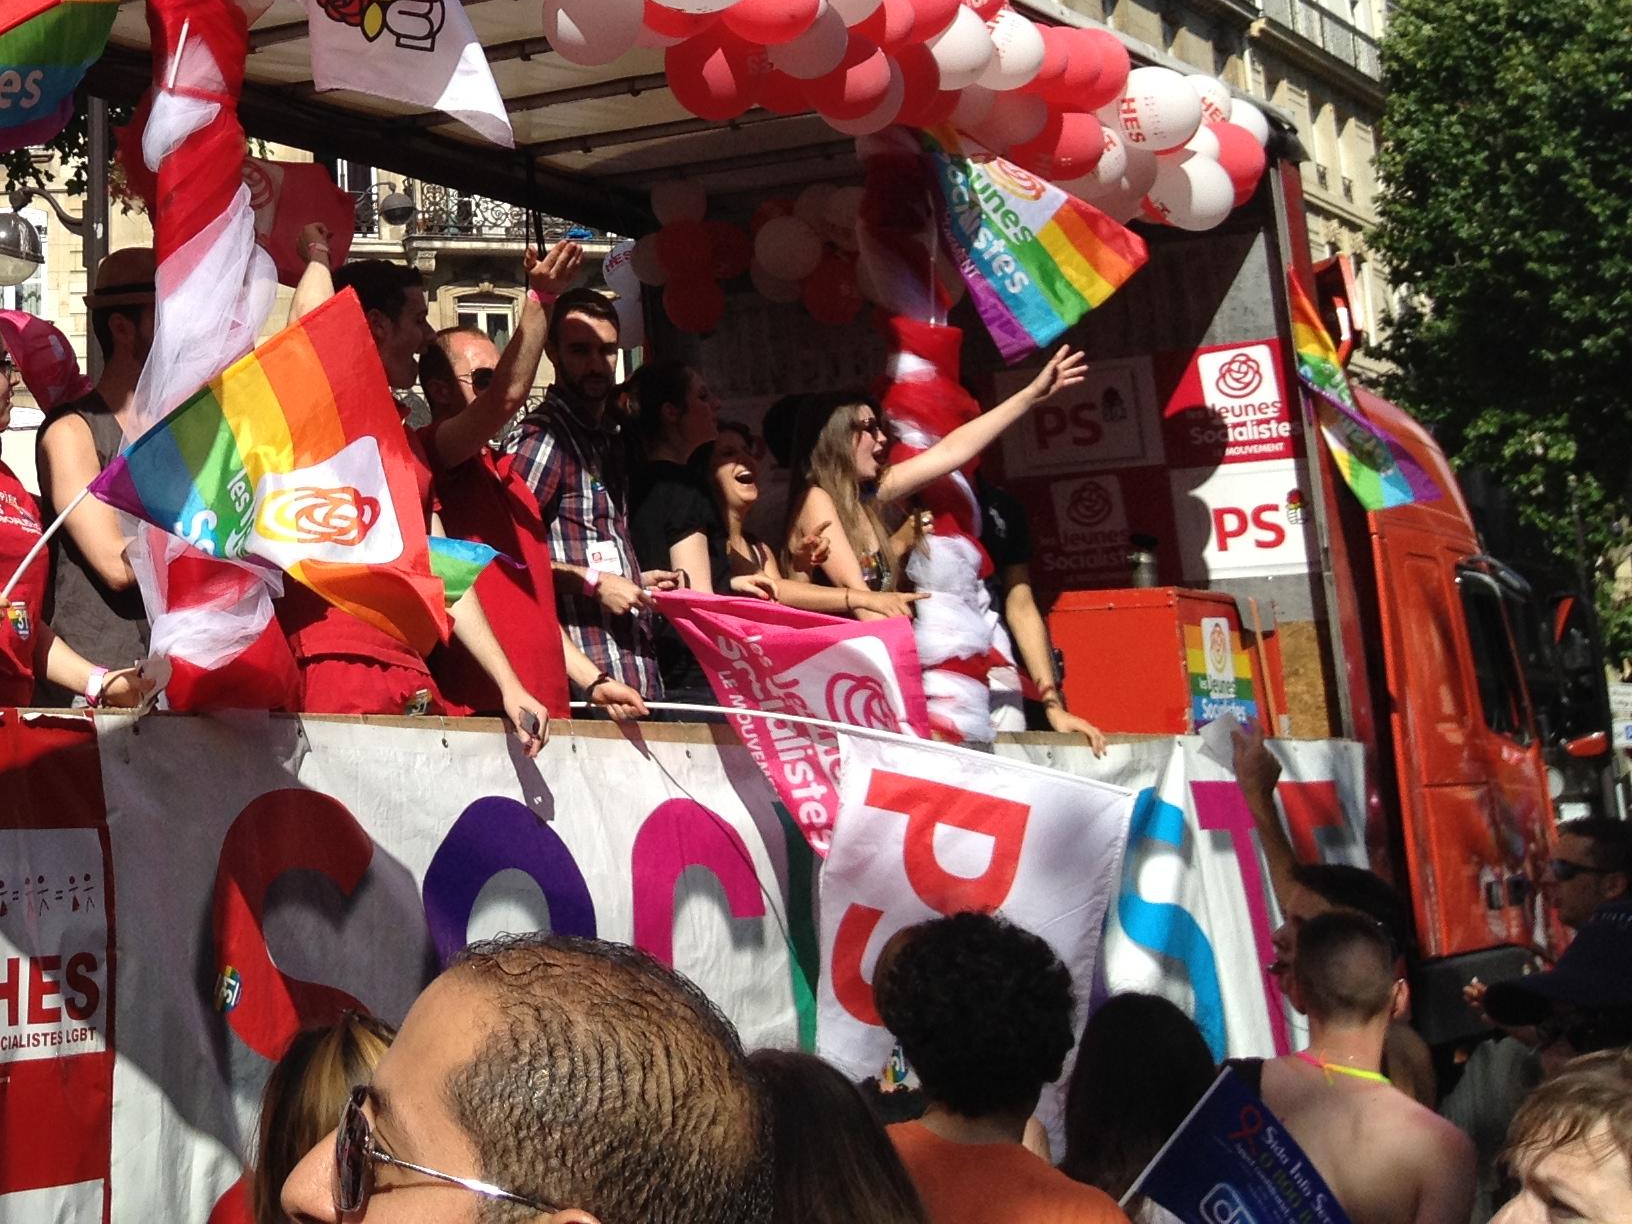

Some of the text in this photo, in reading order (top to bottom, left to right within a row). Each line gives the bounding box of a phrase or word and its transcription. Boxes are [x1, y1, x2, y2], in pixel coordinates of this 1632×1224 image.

[1120, 97, 1147, 144] HES
[1034, 402, 1103, 450] PS
[1211, 400, 1282, 422] Jeunes
[226, 467, 251, 513] les
[1212, 503, 1286, 552] PS
[66, 1026, 97, 1044] LGBT
